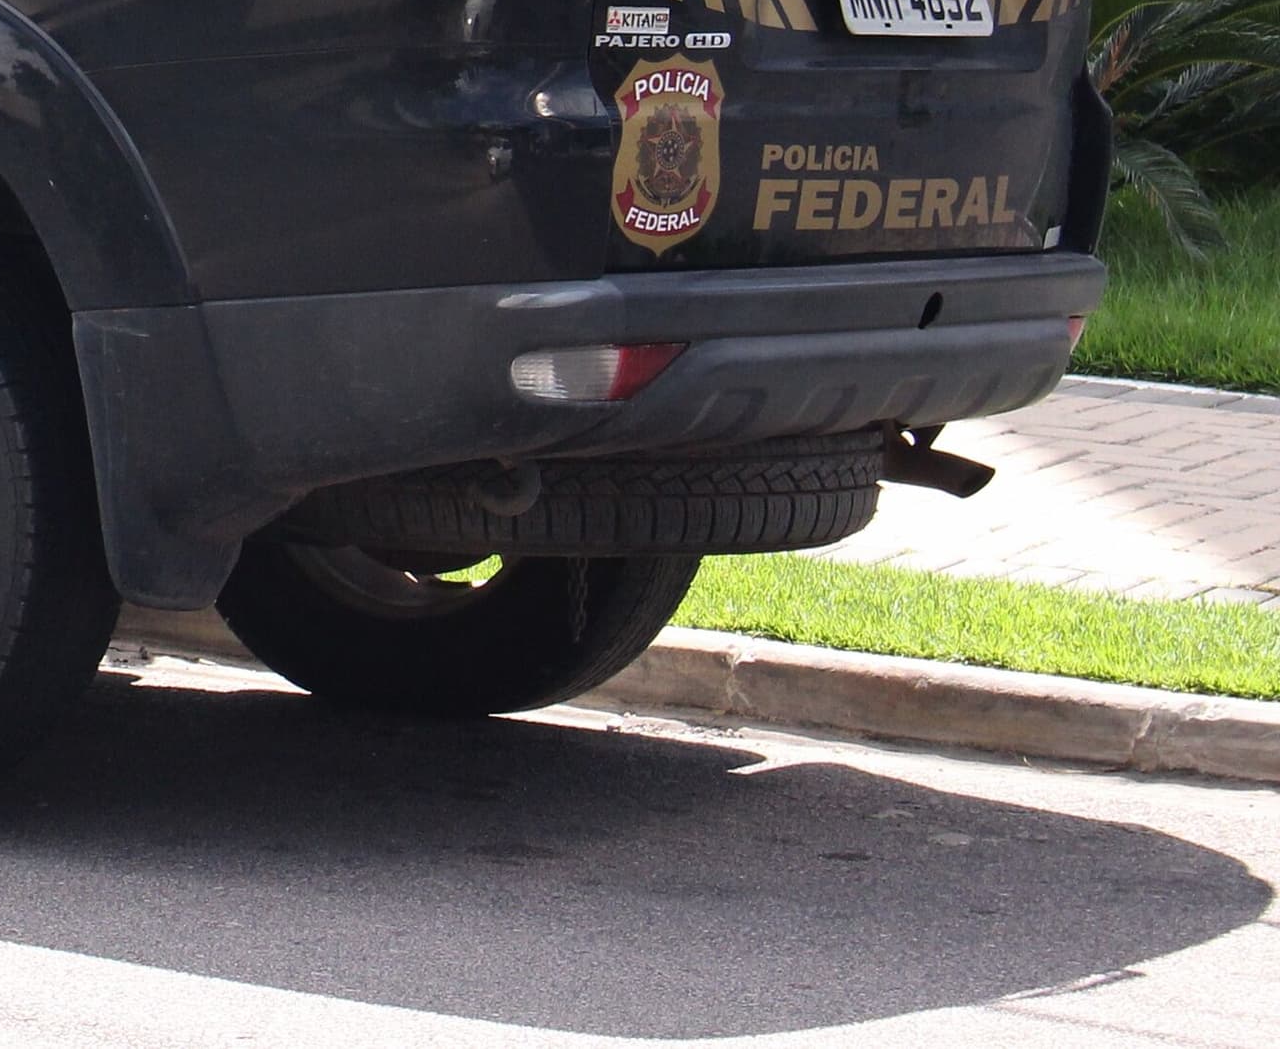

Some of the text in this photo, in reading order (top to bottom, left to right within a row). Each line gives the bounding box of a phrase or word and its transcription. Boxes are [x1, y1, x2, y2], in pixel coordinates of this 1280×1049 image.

[621, 12, 656, 29] KITAI
[594, 34, 724, 48] PAJERO HD
[634, 71, 710, 101] POLÍCIA
[761, 144, 880, 171] POLÍCIA
[752, 175, 1016, 230] FEDERAL
[624, 206, 700, 232] FEDERAL
